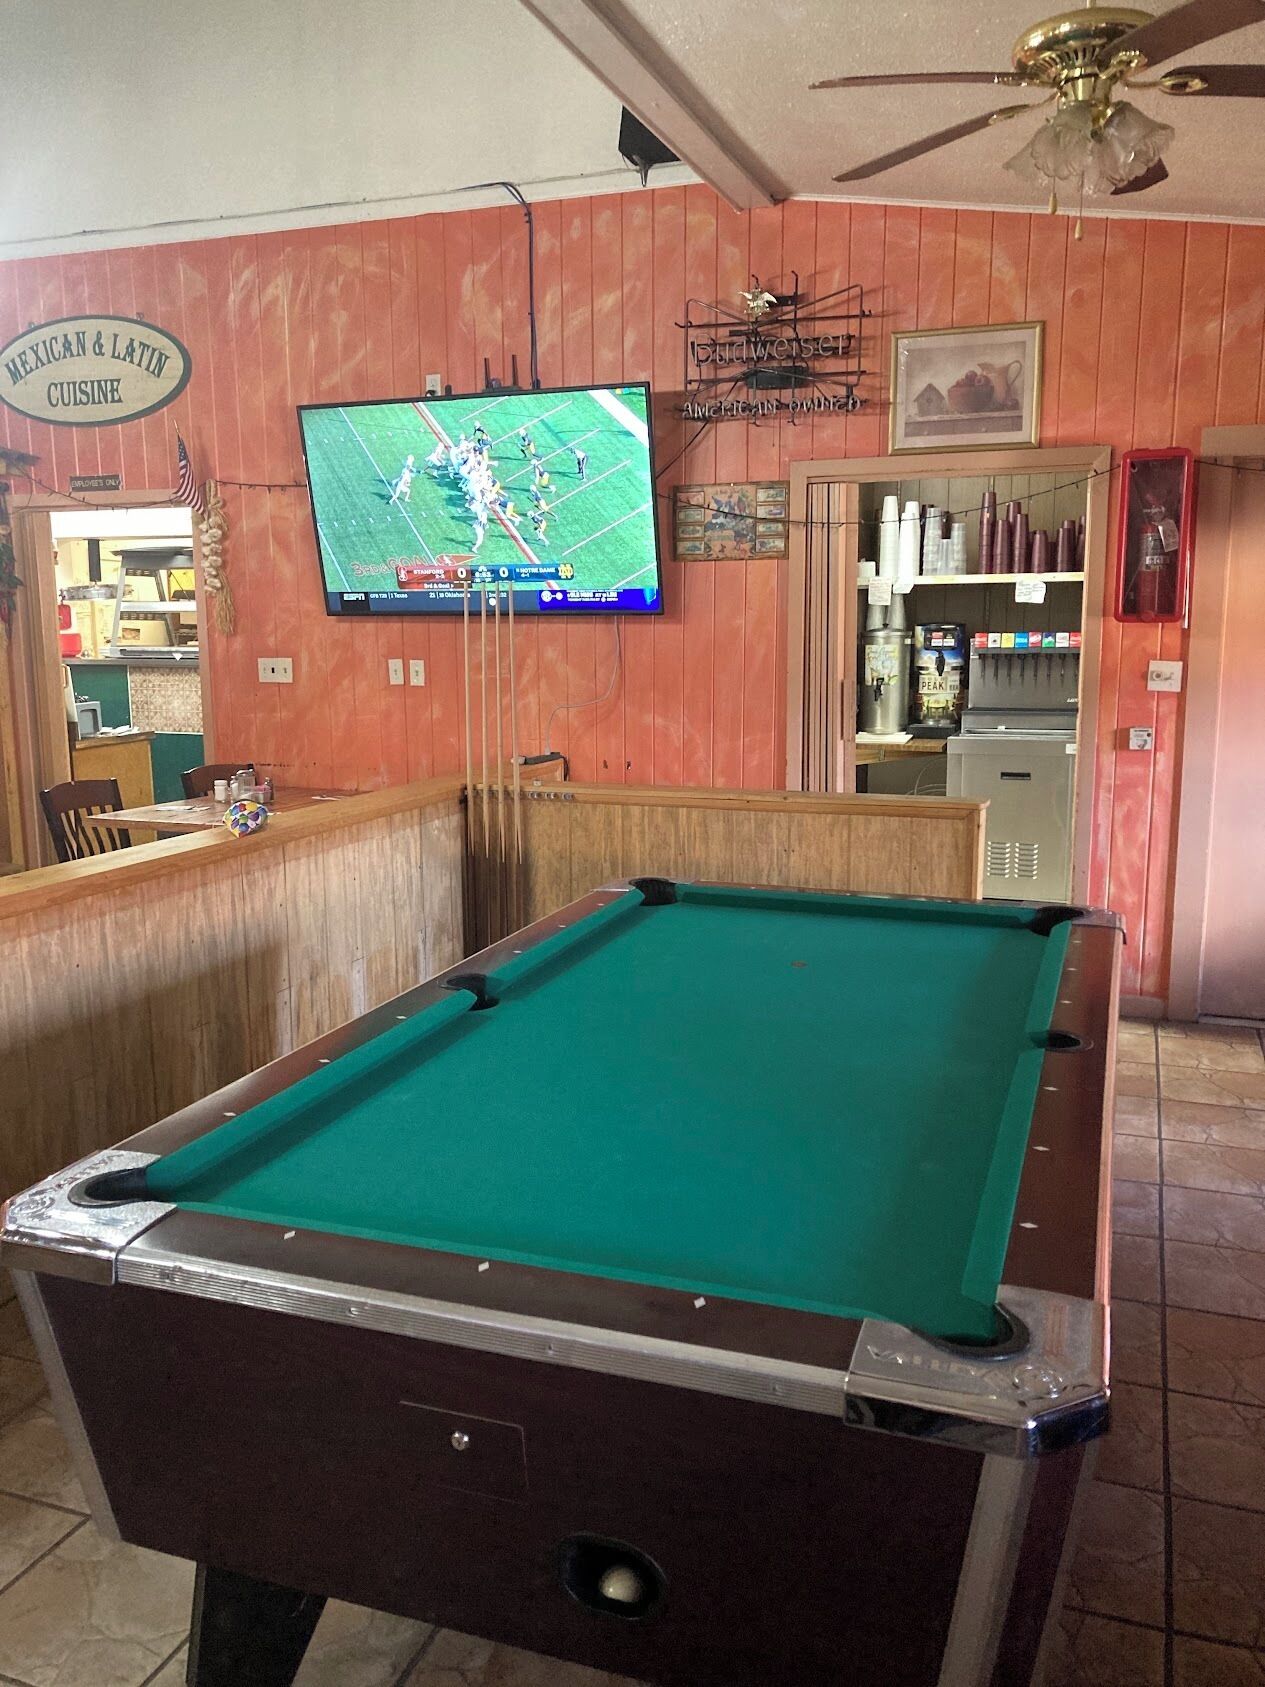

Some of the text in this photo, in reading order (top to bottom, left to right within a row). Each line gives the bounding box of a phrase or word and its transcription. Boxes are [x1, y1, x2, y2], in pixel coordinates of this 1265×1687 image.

[5, 330, 171, 386] MEXICAN & LATIN
[47, 378, 123, 408] CUISINE
[105, 478, 120, 486] ONLY
[457, 567, 467, 579] 0
[499, 566, 509, 578] 0
[343, 593, 365, 601] ESPN
[921, 681, 944, 691] PEAK
